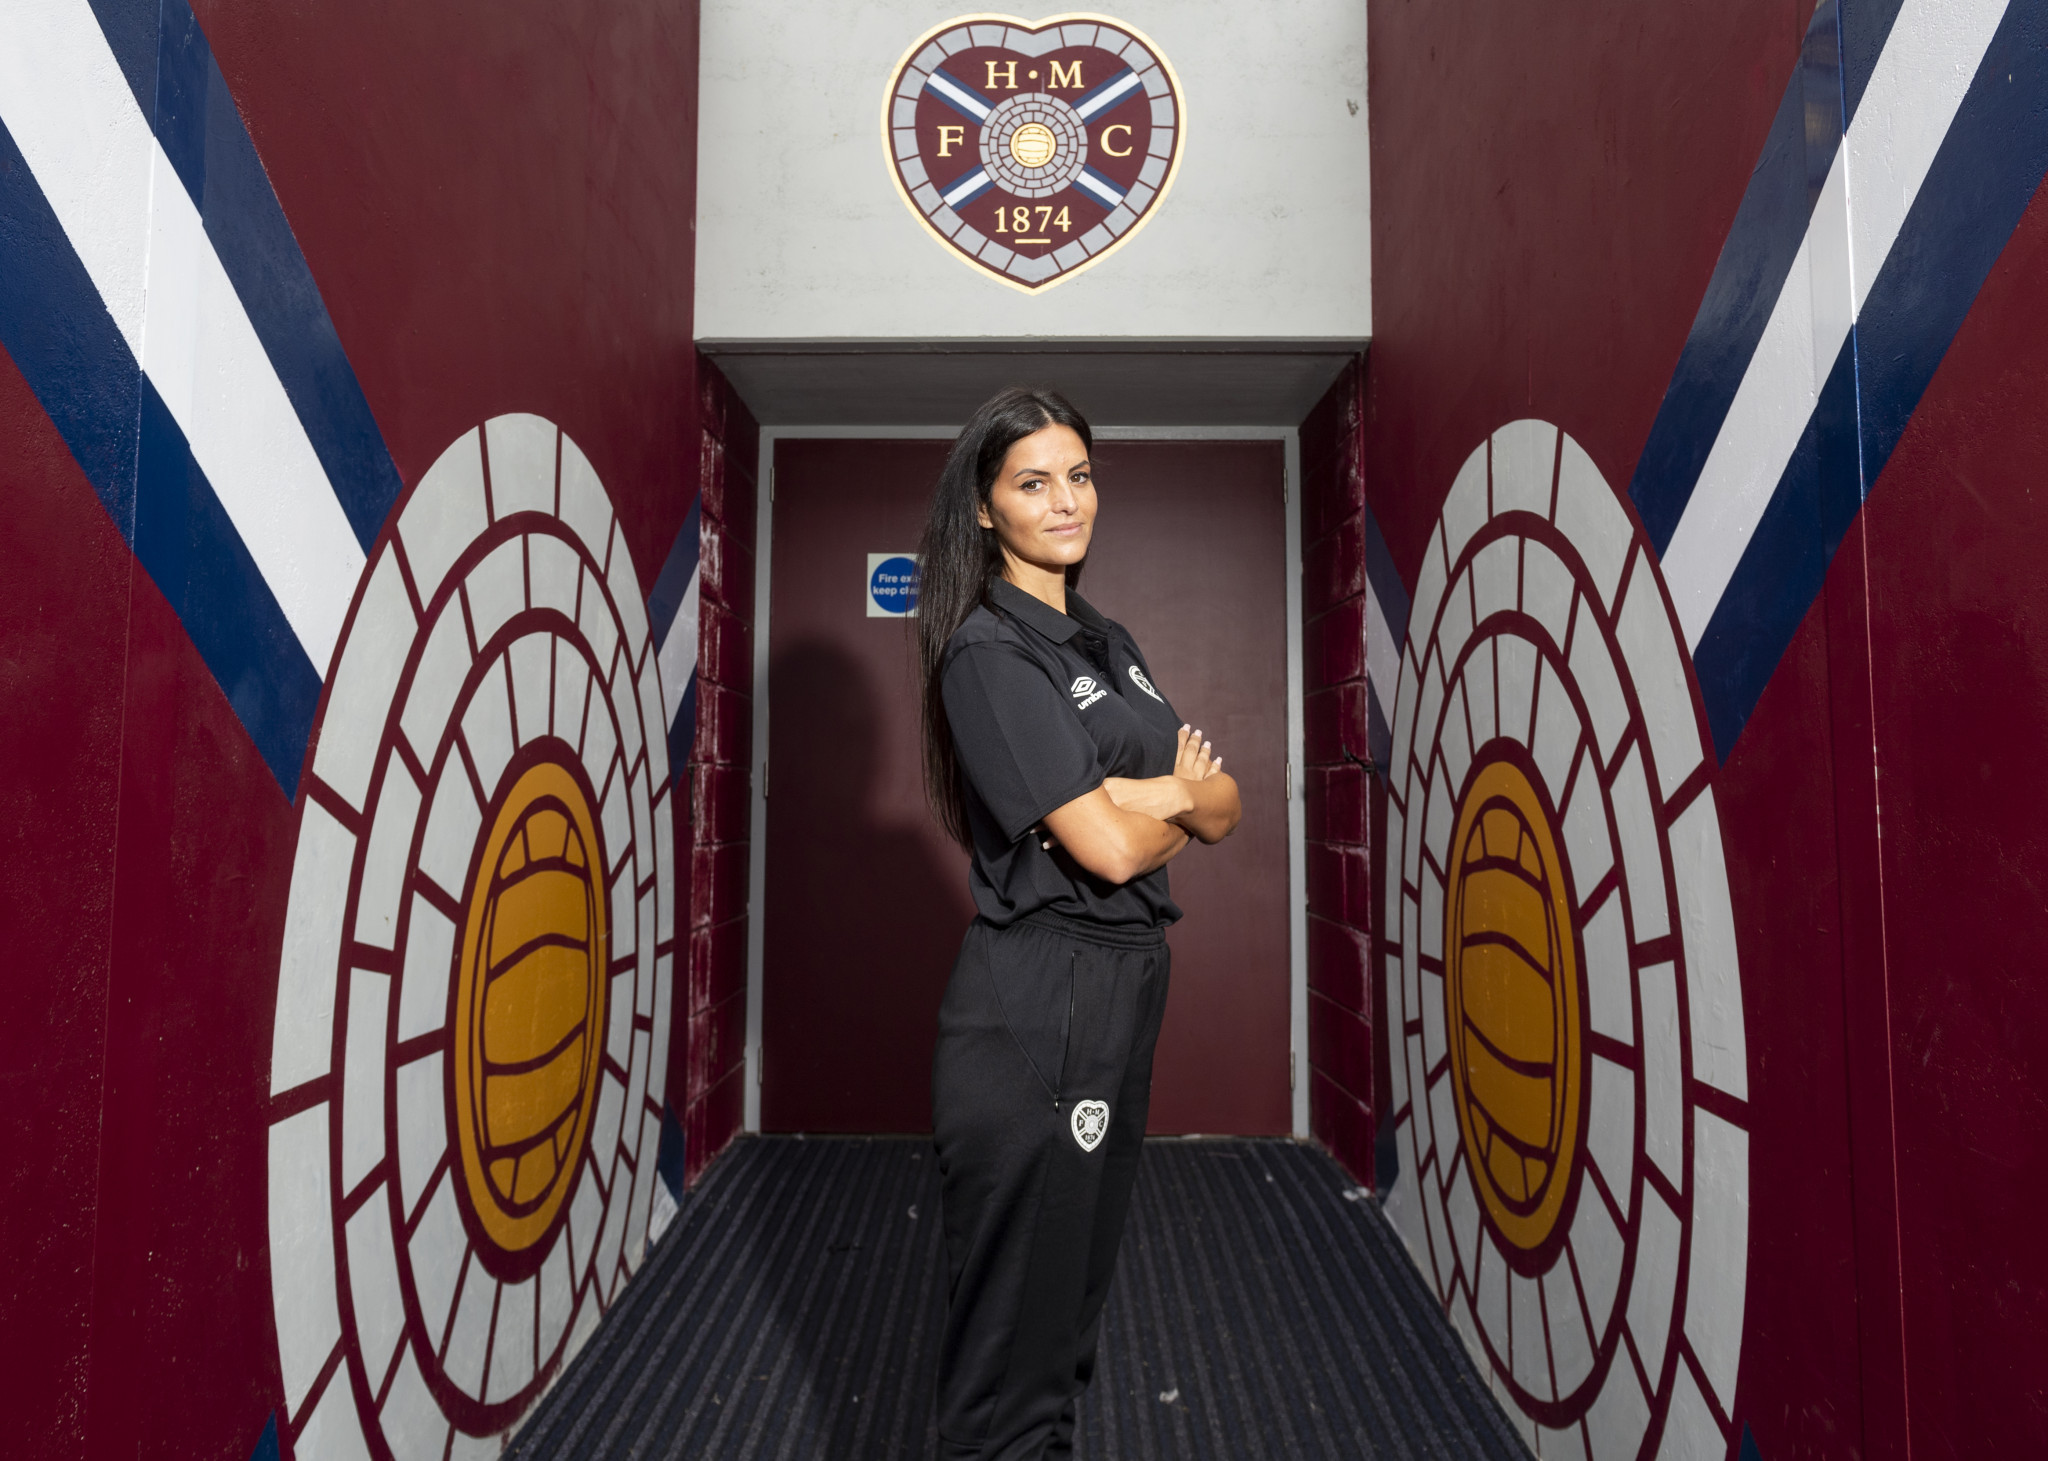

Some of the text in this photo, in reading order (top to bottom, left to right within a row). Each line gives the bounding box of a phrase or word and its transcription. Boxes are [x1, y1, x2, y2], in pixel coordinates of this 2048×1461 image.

[937, 124, 1133, 157] F C
[994, 205, 1072, 233] 1874
[878, 573, 898, 583] Fire
[873, 585, 898, 597] keep
[1078, 689, 1107, 710] umbro
